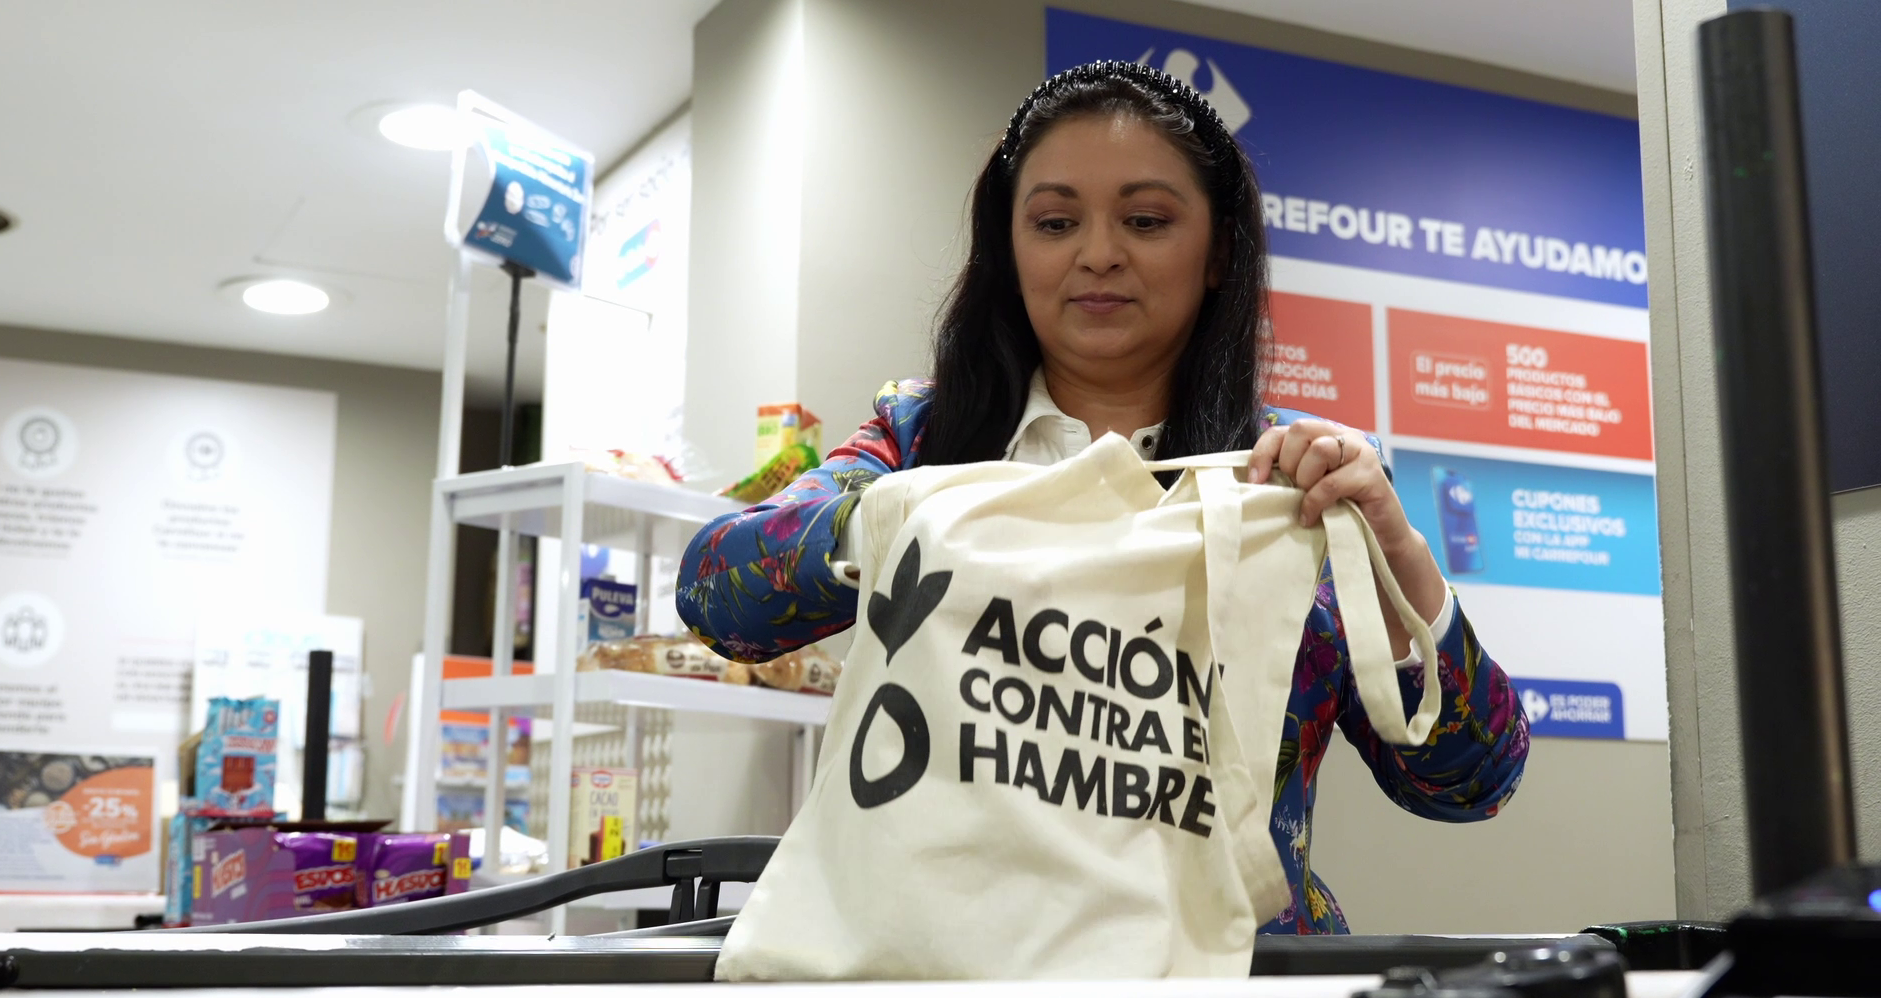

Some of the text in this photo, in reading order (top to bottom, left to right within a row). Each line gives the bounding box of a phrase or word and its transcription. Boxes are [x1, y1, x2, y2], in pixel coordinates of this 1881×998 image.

[1419, 217, 1466, 258] TE
[1471, 226, 1647, 285] AYUDAMO
[1416, 355, 1485, 381] El precio
[1506, 343, 1547, 369] 500
[1506, 366, 1587, 389] PRODUCTOS
[1415, 379, 1488, 406] más bajo
[1563, 387, 1593, 407] CON
[1508, 397, 1556, 416] PRECIO
[1586, 406, 1622, 424] BAJO
[1534, 416, 1600, 437] MERCADO
[1511, 488, 1601, 514] CUPONES
[1513, 509, 1626, 538] EXCLUSIVOS
[1513, 530, 1590, 548] CON LA APP
[592, 586, 634, 605] PULEVA
[961, 596, 1224, 718] ACCIÓN
[959, 668, 1172, 754] CONTRA
[959, 722, 1216, 838] HAMBRE
